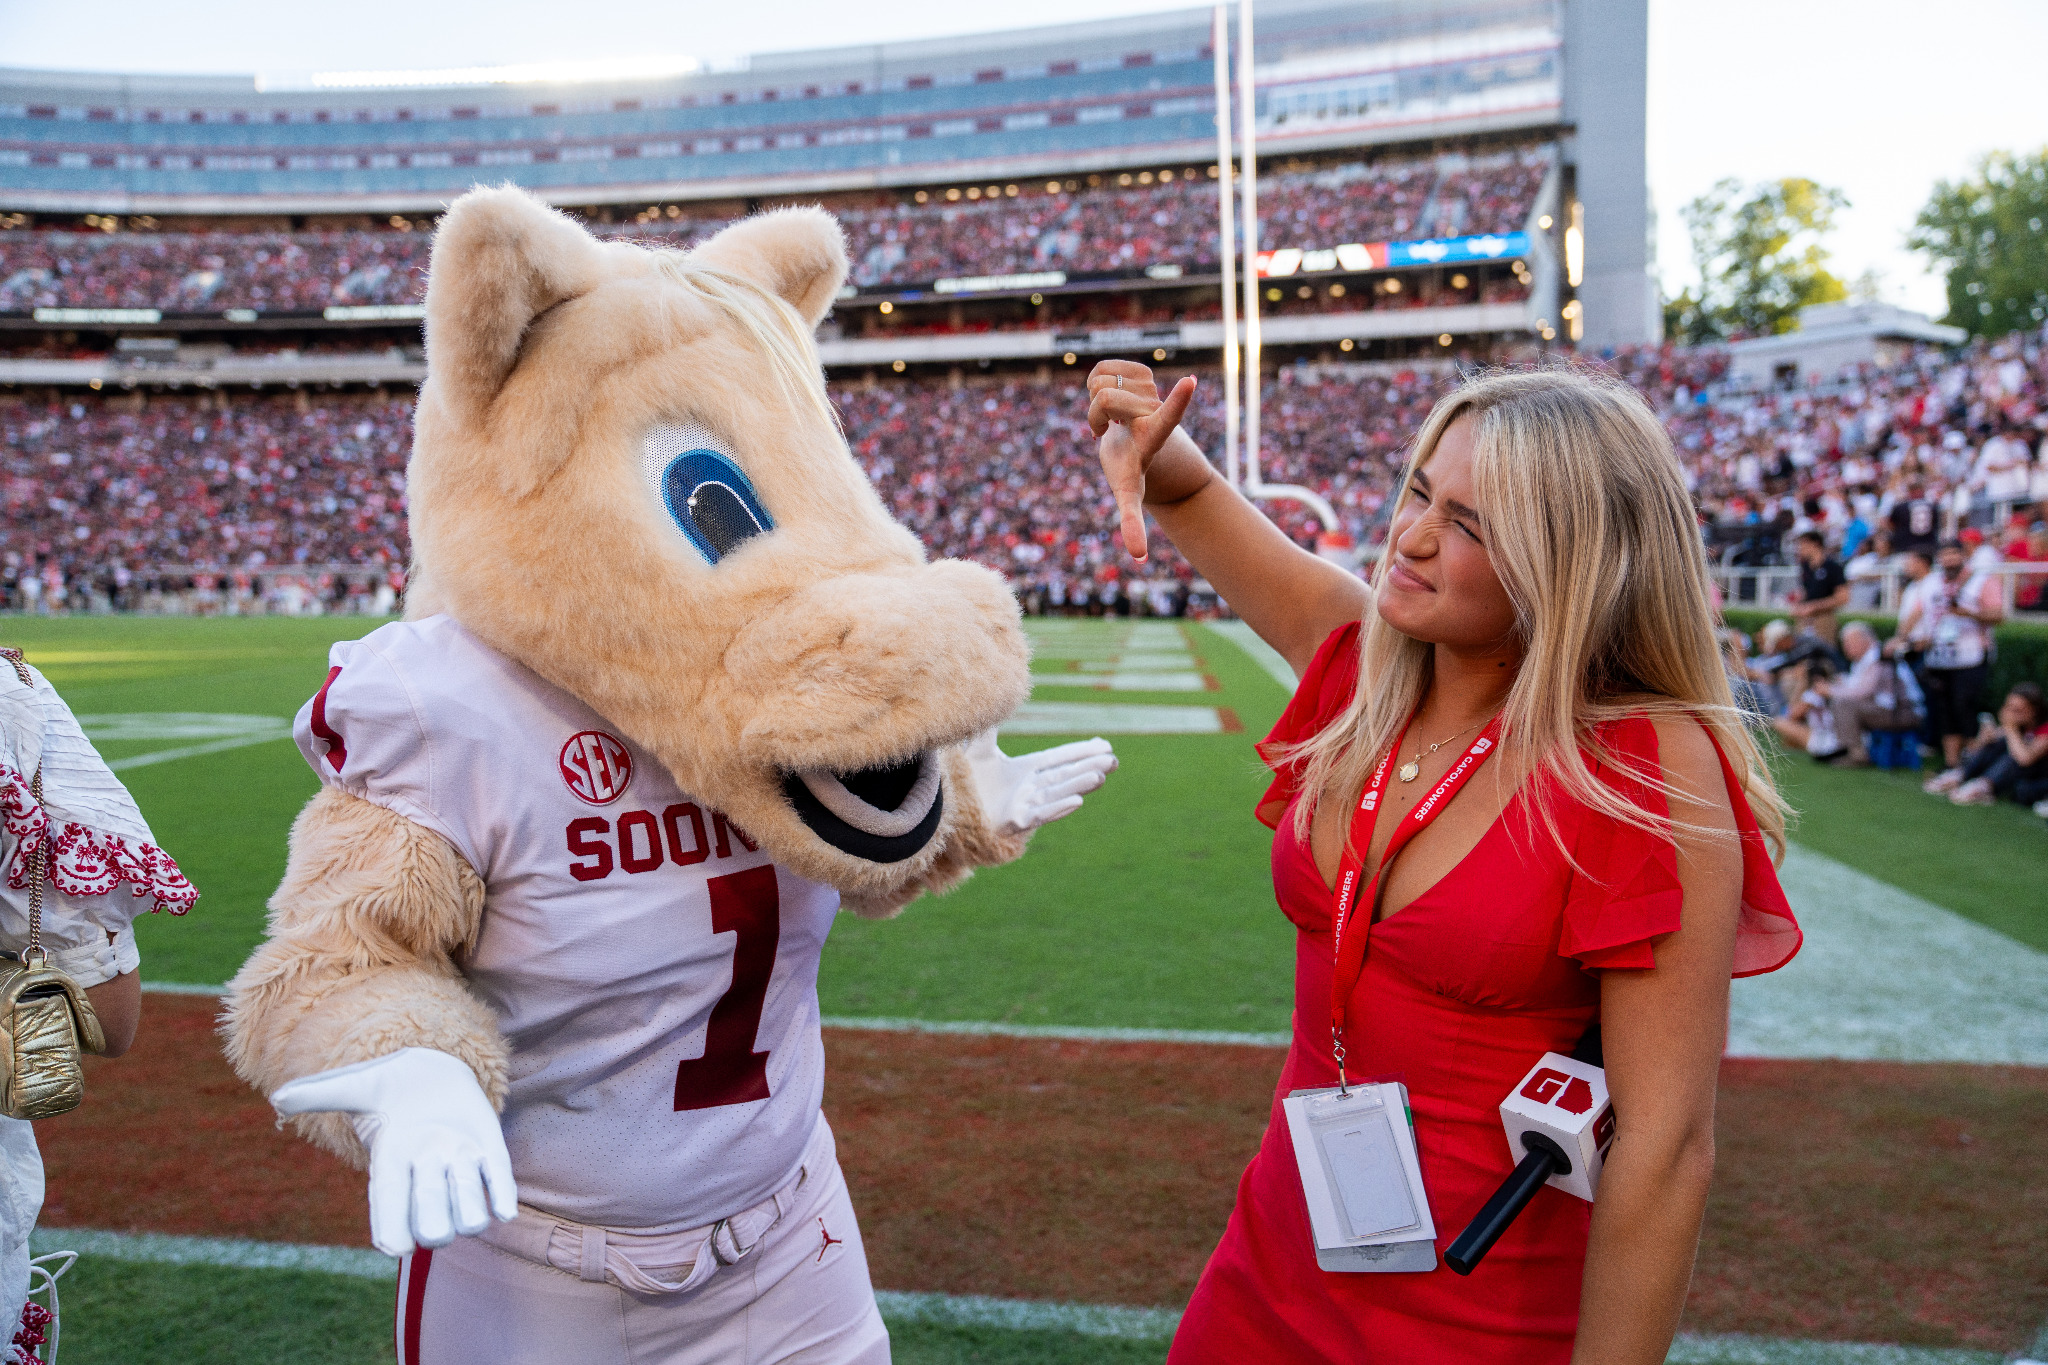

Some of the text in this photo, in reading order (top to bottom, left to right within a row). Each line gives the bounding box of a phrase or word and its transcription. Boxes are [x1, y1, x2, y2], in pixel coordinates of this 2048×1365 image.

[563, 733, 630, 800] SEC
[1371, 749, 1391, 788] GAFOL
[1414, 756, 1473, 822] GAFOLLOWERS
[673, 864, 780, 1111] 1
